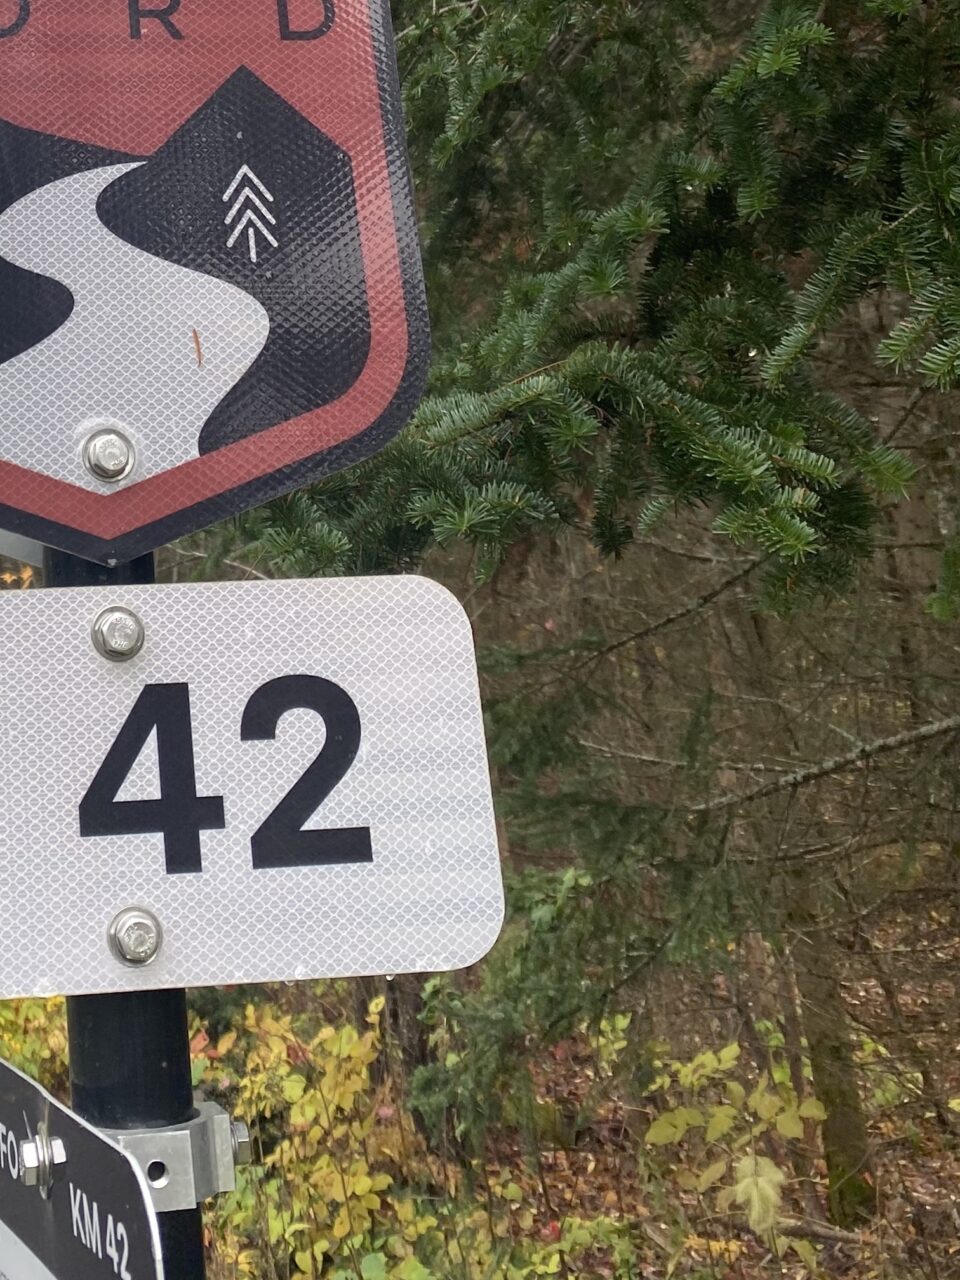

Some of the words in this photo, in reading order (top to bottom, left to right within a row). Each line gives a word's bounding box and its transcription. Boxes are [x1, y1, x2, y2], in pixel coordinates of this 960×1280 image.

[79, 674, 374, 875] 42
[69, 1181, 103, 1260] KM
[105, 1213, 132, 1280] 42
